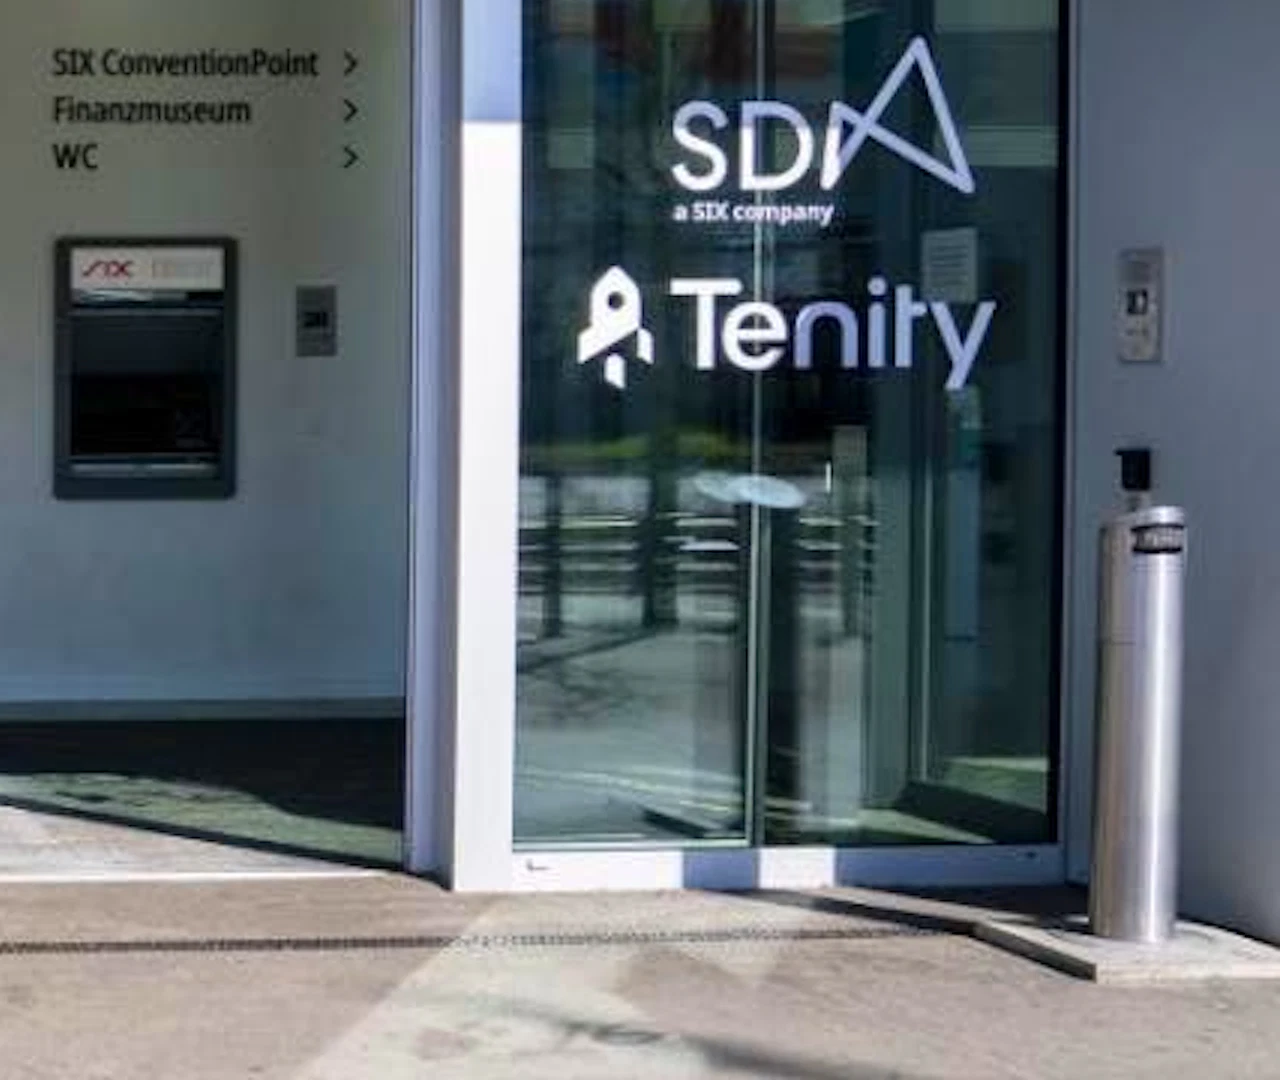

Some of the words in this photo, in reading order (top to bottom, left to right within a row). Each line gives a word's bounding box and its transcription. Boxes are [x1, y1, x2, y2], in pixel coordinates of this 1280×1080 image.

[52, 48, 95, 76] SIX
[102, 48, 320, 77] ConventionPoint
[54, 95, 252, 123] Finanzmuseum
[52, 142, 99, 170] WC
[673, 203, 688, 221] a
[692, 201, 729, 222] SIX
[732, 204, 835, 227] company
[669, 277, 997, 391] Tenity
